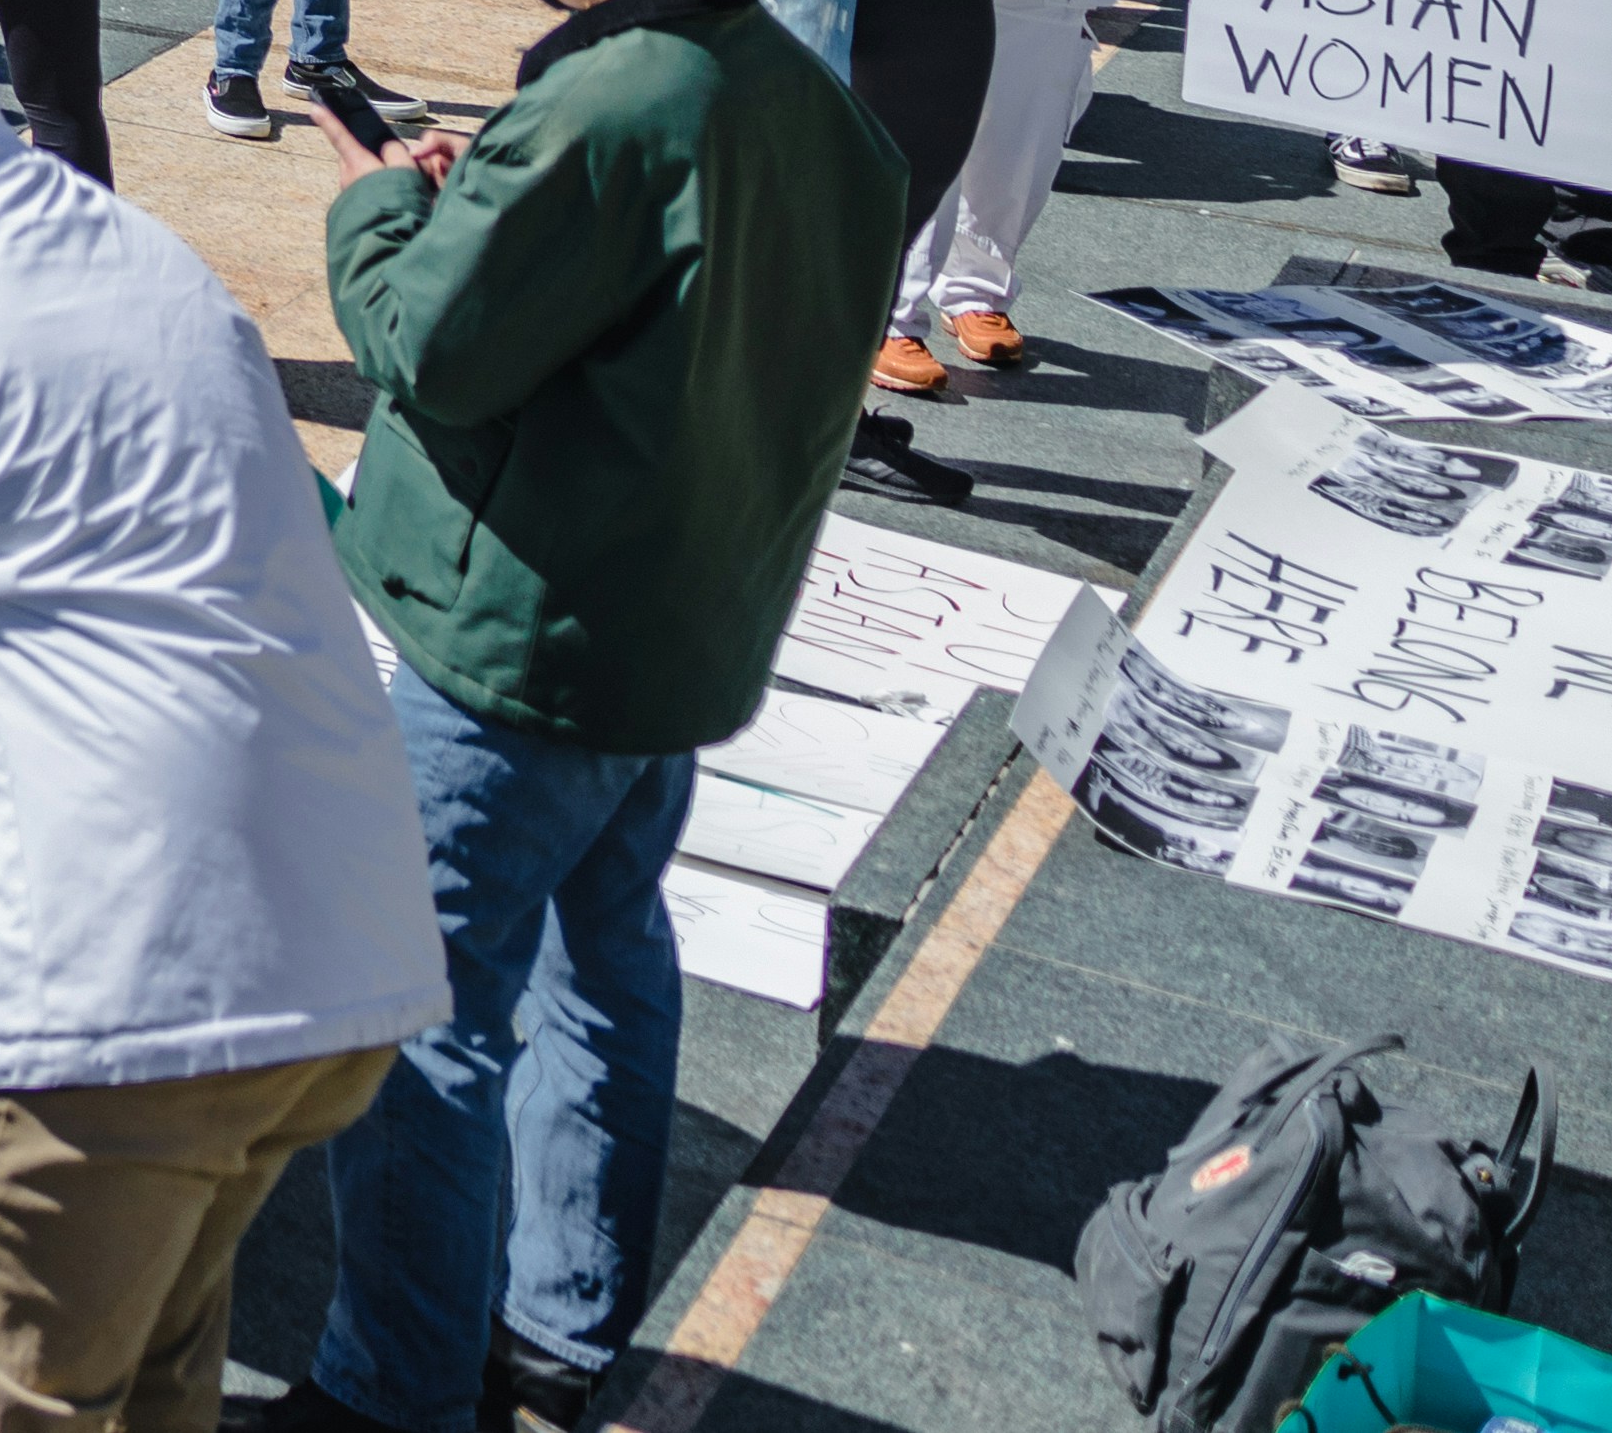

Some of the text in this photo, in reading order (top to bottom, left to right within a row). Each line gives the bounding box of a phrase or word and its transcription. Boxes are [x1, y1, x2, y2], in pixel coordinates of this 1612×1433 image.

[1224, 23, 1554, 148] WOMEN
[1179, 528, 1359, 665] HERE
[1312, 566, 1545, 724] BELONG
